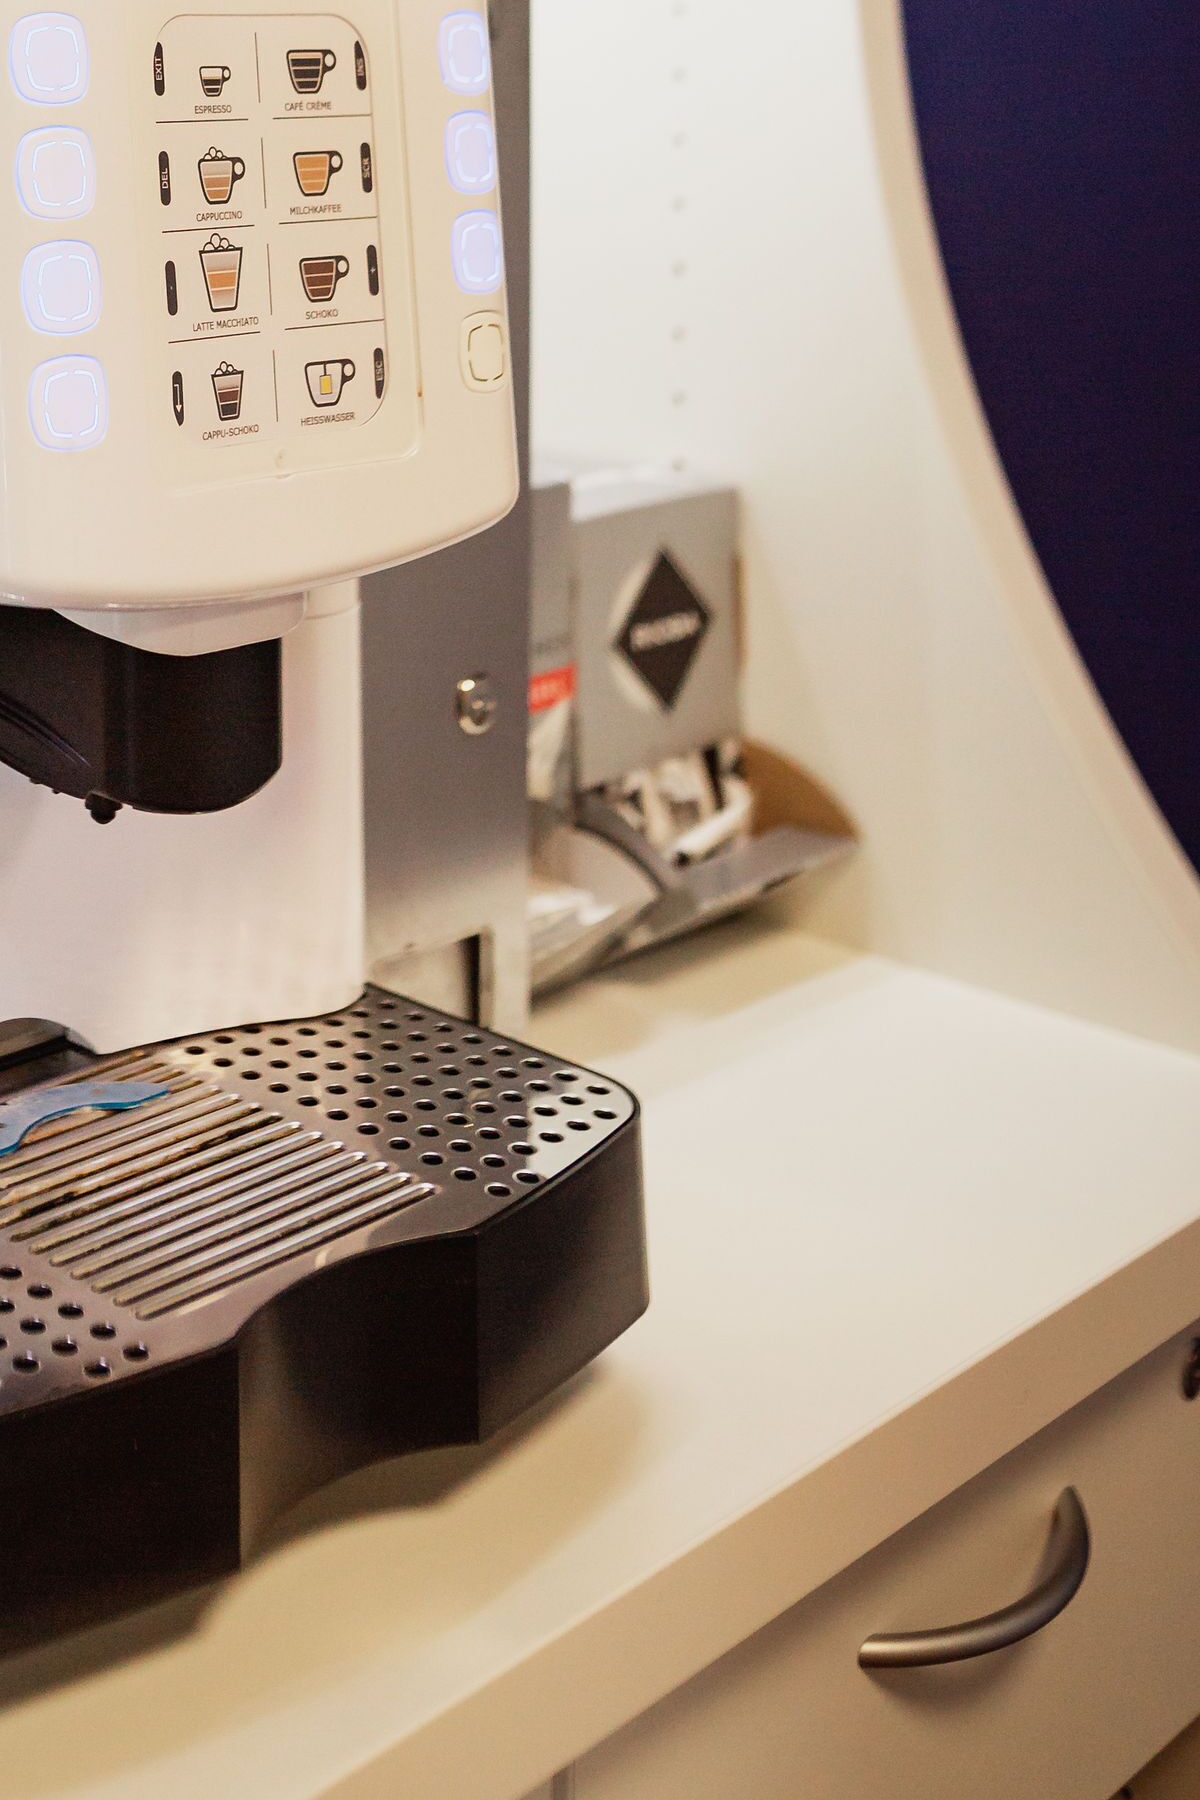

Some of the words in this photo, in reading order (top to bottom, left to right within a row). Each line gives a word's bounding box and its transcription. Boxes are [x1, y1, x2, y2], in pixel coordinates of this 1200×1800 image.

[155, 57, 163, 81] EXIT
[194, 104, 232, 114] ESPRESSO
[284, 100, 304, 111] CAFÉ
[161, 167, 169, 189] DEL
[196, 210, 243, 222] CAPPUCCINO
[289, 203, 342, 215] MILCHKAFFEE
[305, 308, 339, 320] SCHOKO
[192, 320, 215, 332] LATTE
[216, 316, 260, 329] MACCHIATO
[300, 411, 356, 427] HEISSWASSER
[202, 424, 260, 441] CAPPU-SCHOKO
